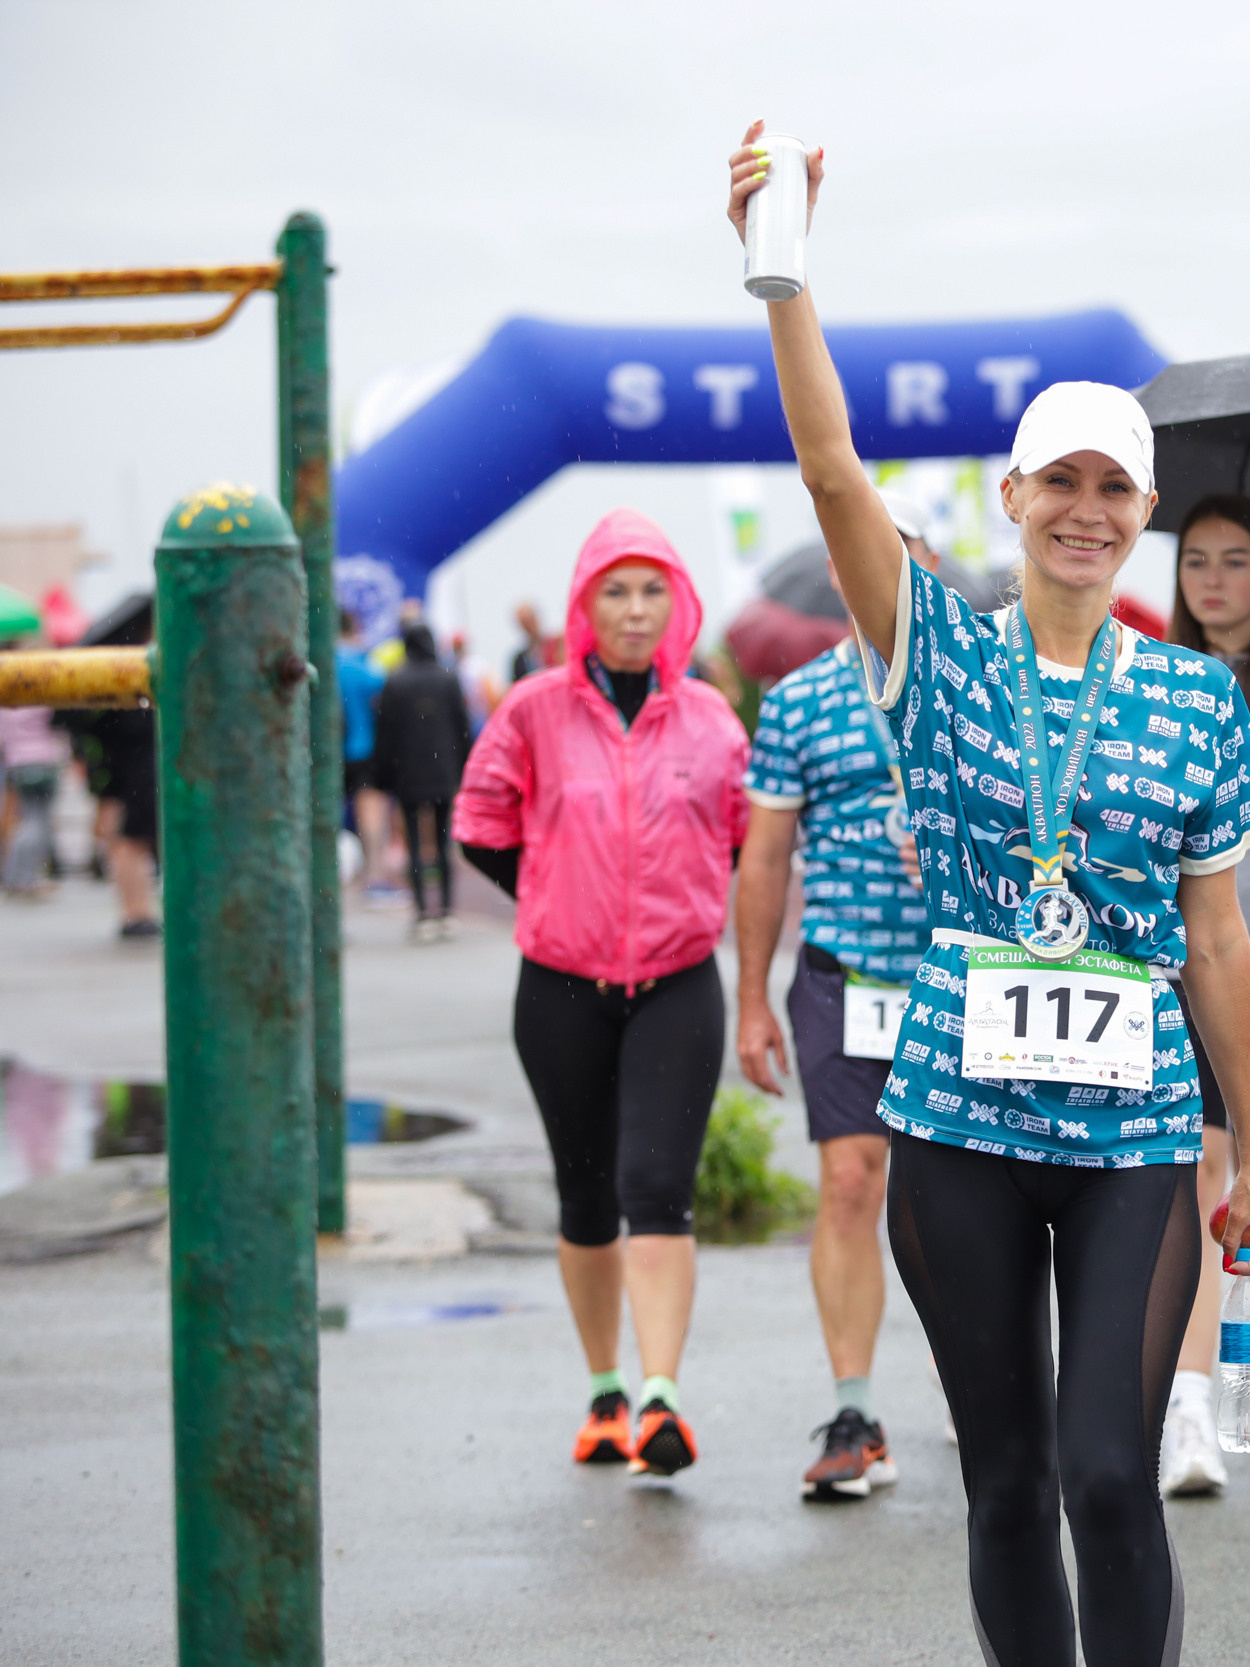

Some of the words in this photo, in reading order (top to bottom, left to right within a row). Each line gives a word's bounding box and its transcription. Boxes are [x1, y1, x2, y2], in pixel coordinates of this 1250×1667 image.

[604, 356, 1041, 431] STRT
[1144, 655, 1163, 663] IRON
[1146, 662, 1167, 670] TEAM
[948, 661, 962, 678] IRON
[946, 670, 961, 687] TEAM
[1017, 668, 1030, 694] этап
[1085, 683, 1100, 708] этап
[1196, 701, 1213, 712] TEAM
[971, 725, 986, 740] IRON
[1022, 722, 1038, 750] 2022
[969, 734, 986, 750] TEAM
[1108, 750, 1131, 758] TEAM
[1054, 729, 1089, 817] ВЛАДИВОСТОК
[1000, 784, 1020, 797] IRON
[1156, 785, 1171, 796] IRON
[998, 793, 1021, 806] TEAM
[1155, 794, 1173, 805] TEAM
[1029, 774, 1048, 845] АКВАТЛОН
[1075, 954, 1142, 976] ЭСТАФЕТА
[873, 1001, 905, 1031] 1
[1004, 985, 1120, 1043] 117
[926, 1100, 958, 1113] TRIATHLON
[1026, 1116, 1045, 1126] IRON
[1026, 1124, 1049, 1133] TEAM
